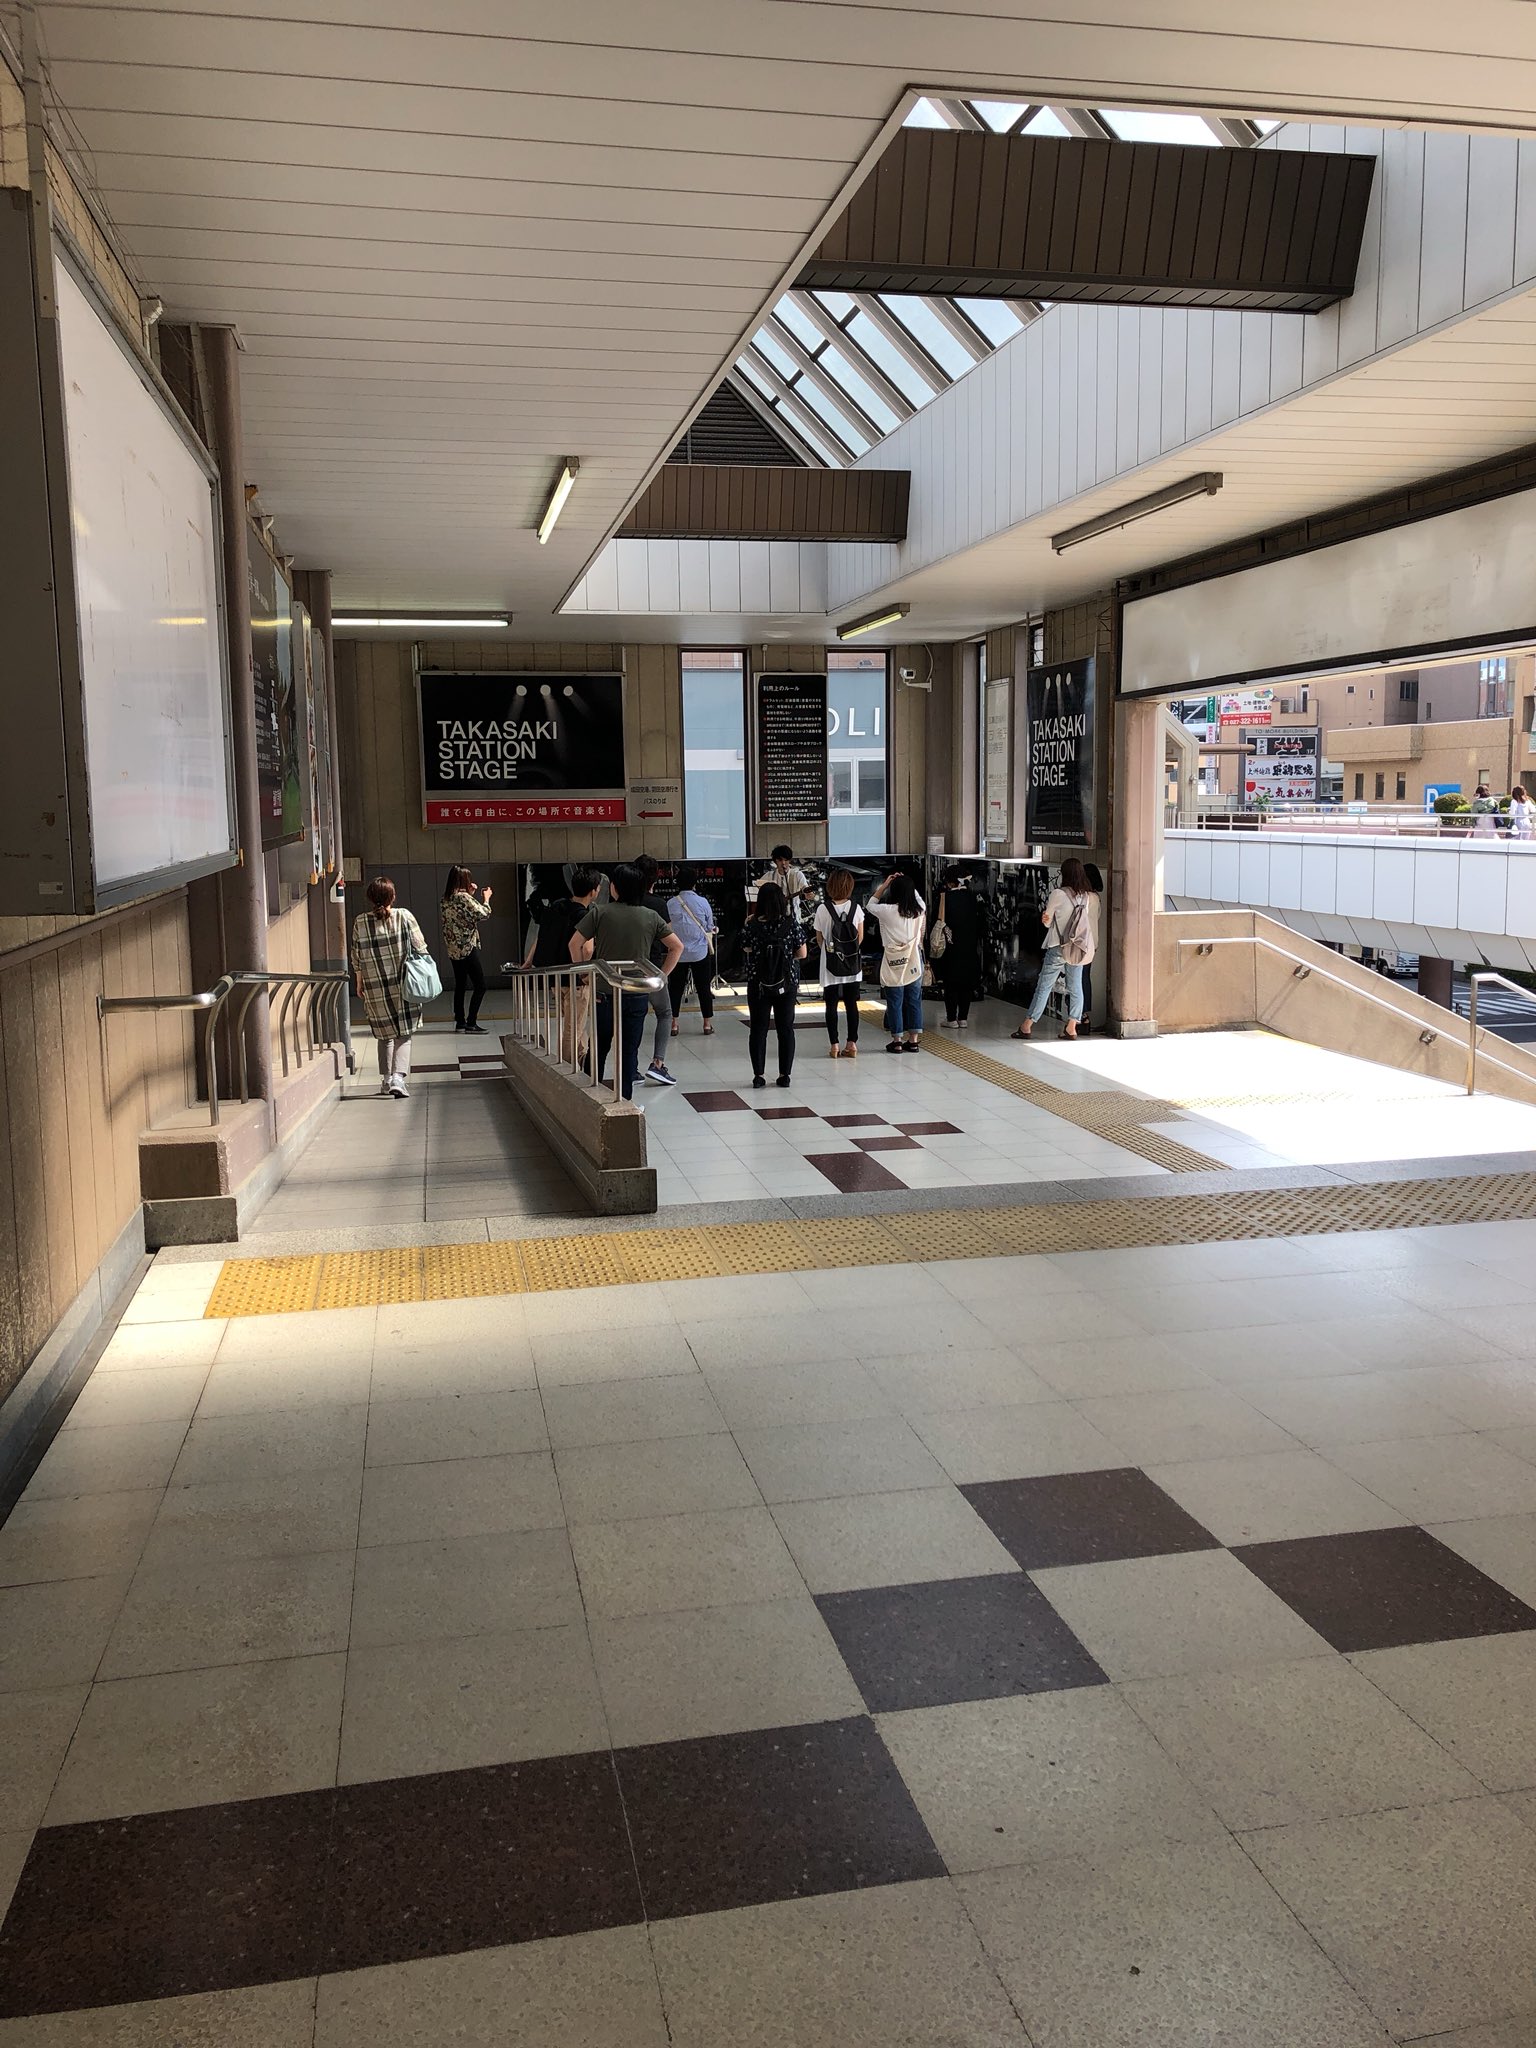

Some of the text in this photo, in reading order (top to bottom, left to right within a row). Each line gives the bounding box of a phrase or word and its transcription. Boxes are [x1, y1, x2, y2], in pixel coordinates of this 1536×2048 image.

[437, 720, 558, 740] TAKASAKI
[1032, 713, 1086, 741] TAKASAKI
[438, 740, 537, 760] STATION
[1032, 739, 1075, 765] STATION
[439, 760, 517, 780] STAGE
[643, 797, 667, 805] バスのりば
[1264, 786, 1314, 799] 元気集会所
